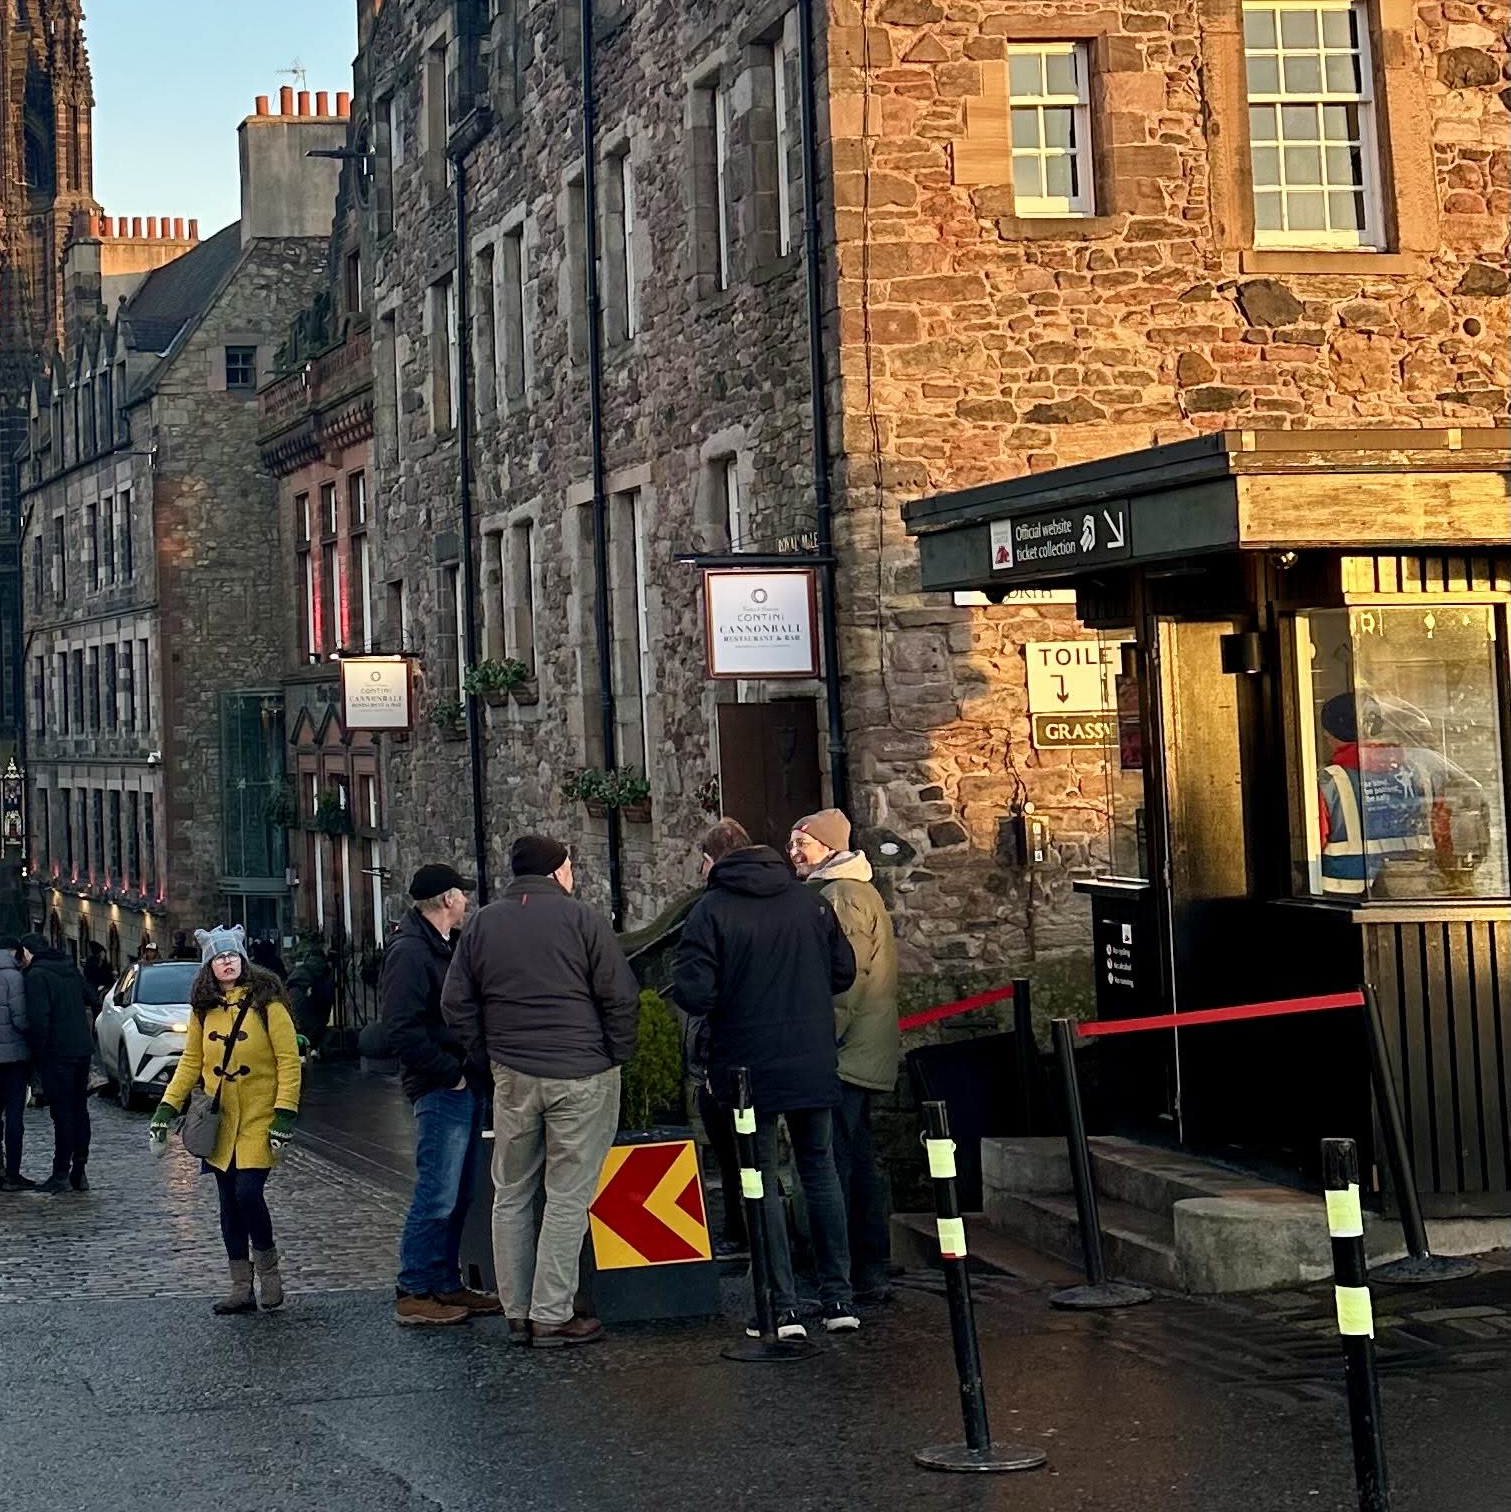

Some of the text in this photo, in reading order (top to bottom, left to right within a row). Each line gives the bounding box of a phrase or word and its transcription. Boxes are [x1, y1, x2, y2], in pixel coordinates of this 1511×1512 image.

[1015, 522, 1041, 542] Official
[1041, 518, 1073, 538] website
[1016, 539, 1076, 562] ticket collection
[738, 613, 785, 622] CONTINI
[719, 624, 803, 634] CANNONBALL
[723, 635, 774, 643] RESTAURANT
[1038, 647, 1121, 666] TOILE
